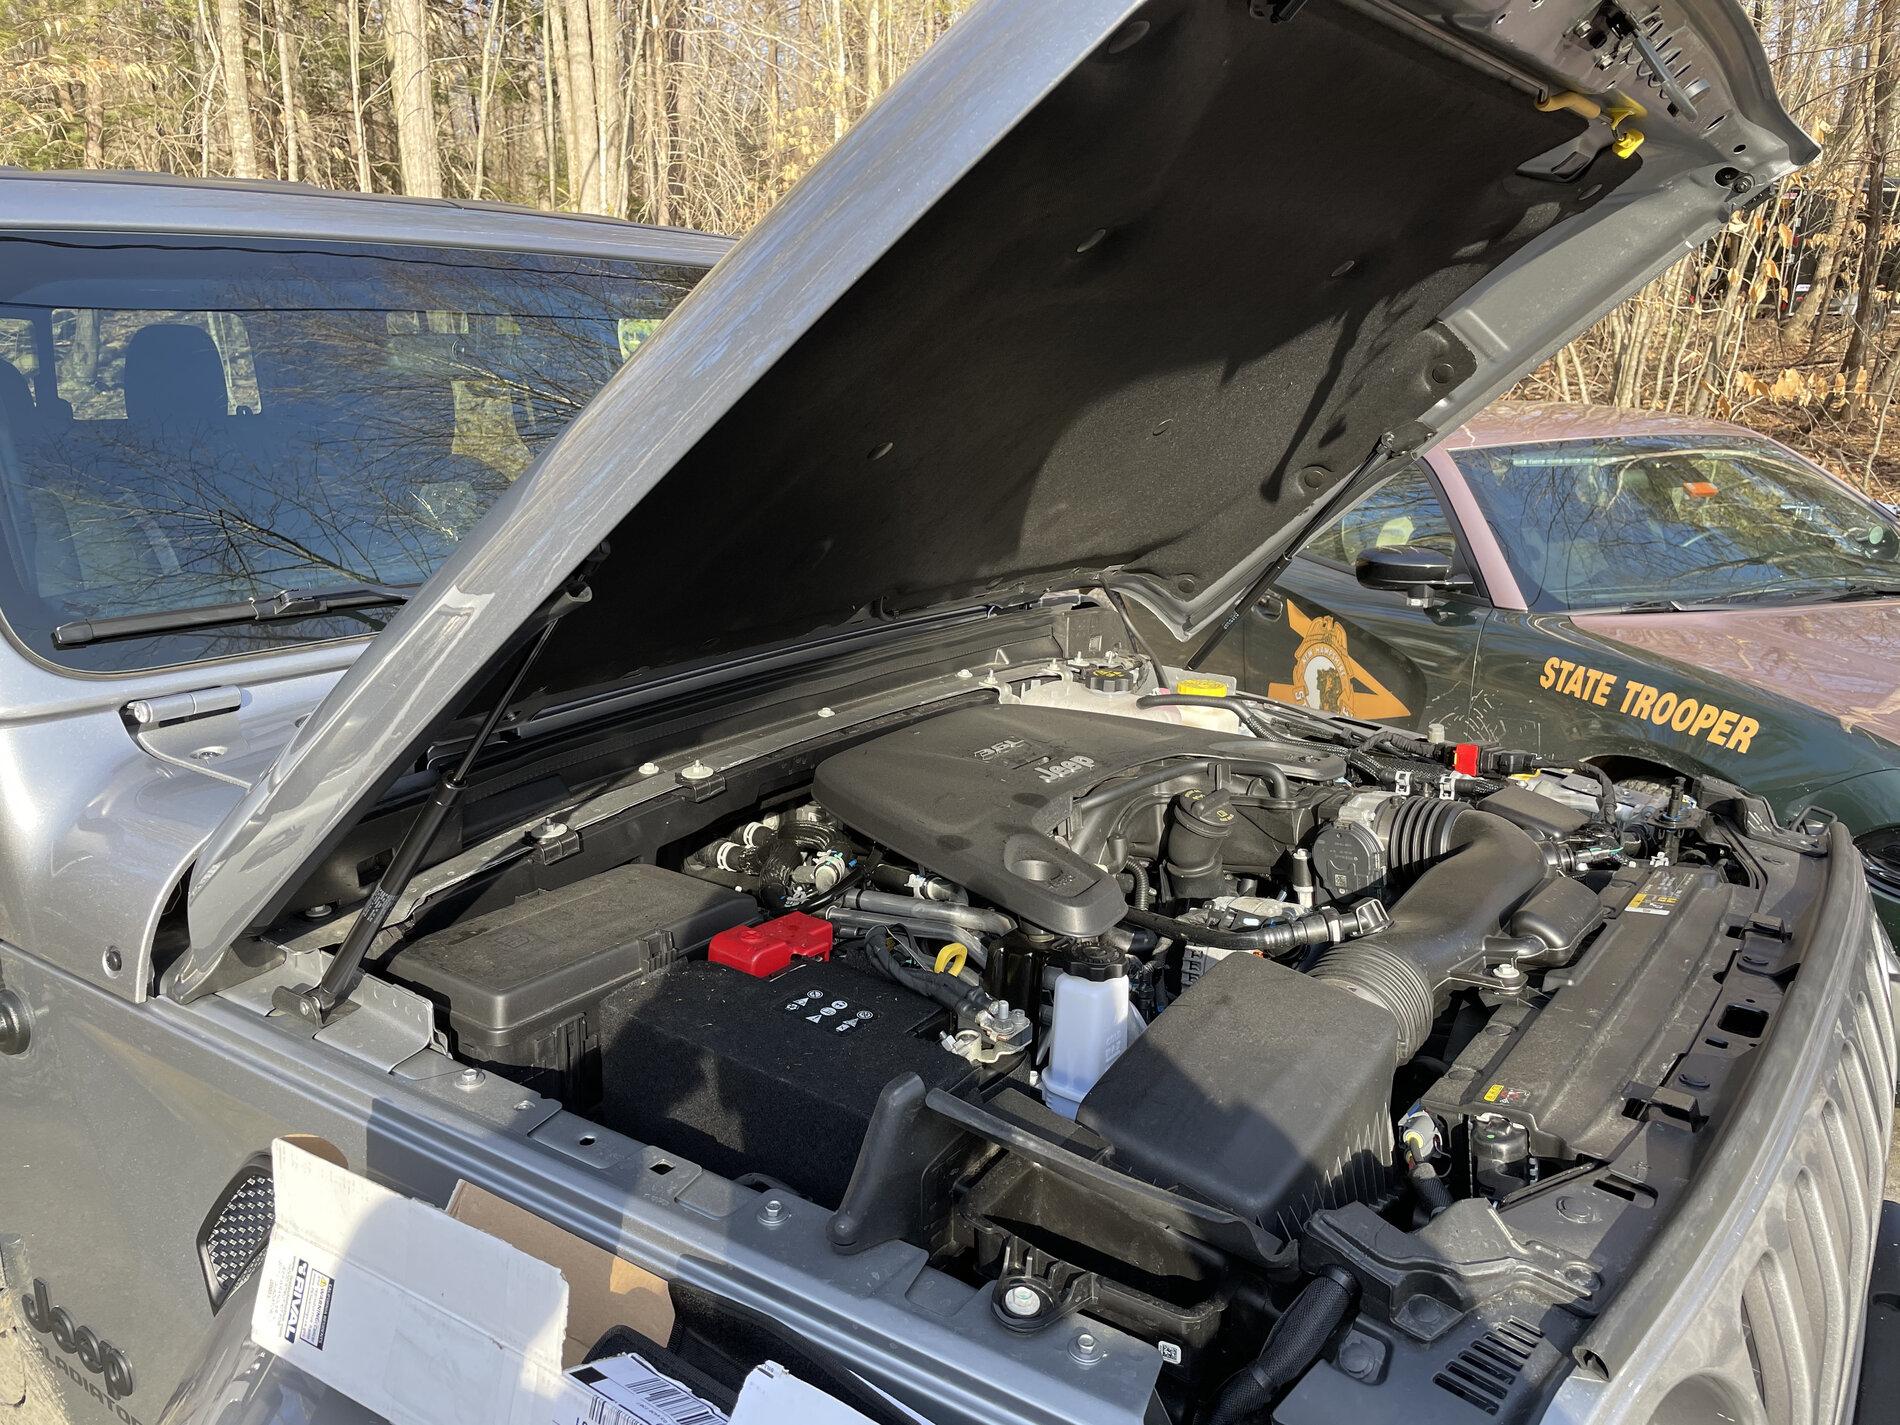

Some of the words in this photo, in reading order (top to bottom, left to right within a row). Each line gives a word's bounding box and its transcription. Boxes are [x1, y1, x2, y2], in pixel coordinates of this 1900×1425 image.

[1539, 656, 1618, 707] STATE
[1619, 680, 1760, 754] TROOPER
[1034, 755, 1095, 783] Jeep
[21, 1277, 133, 1401] Jeep
[286, 1275, 305, 1338] RIVAL
